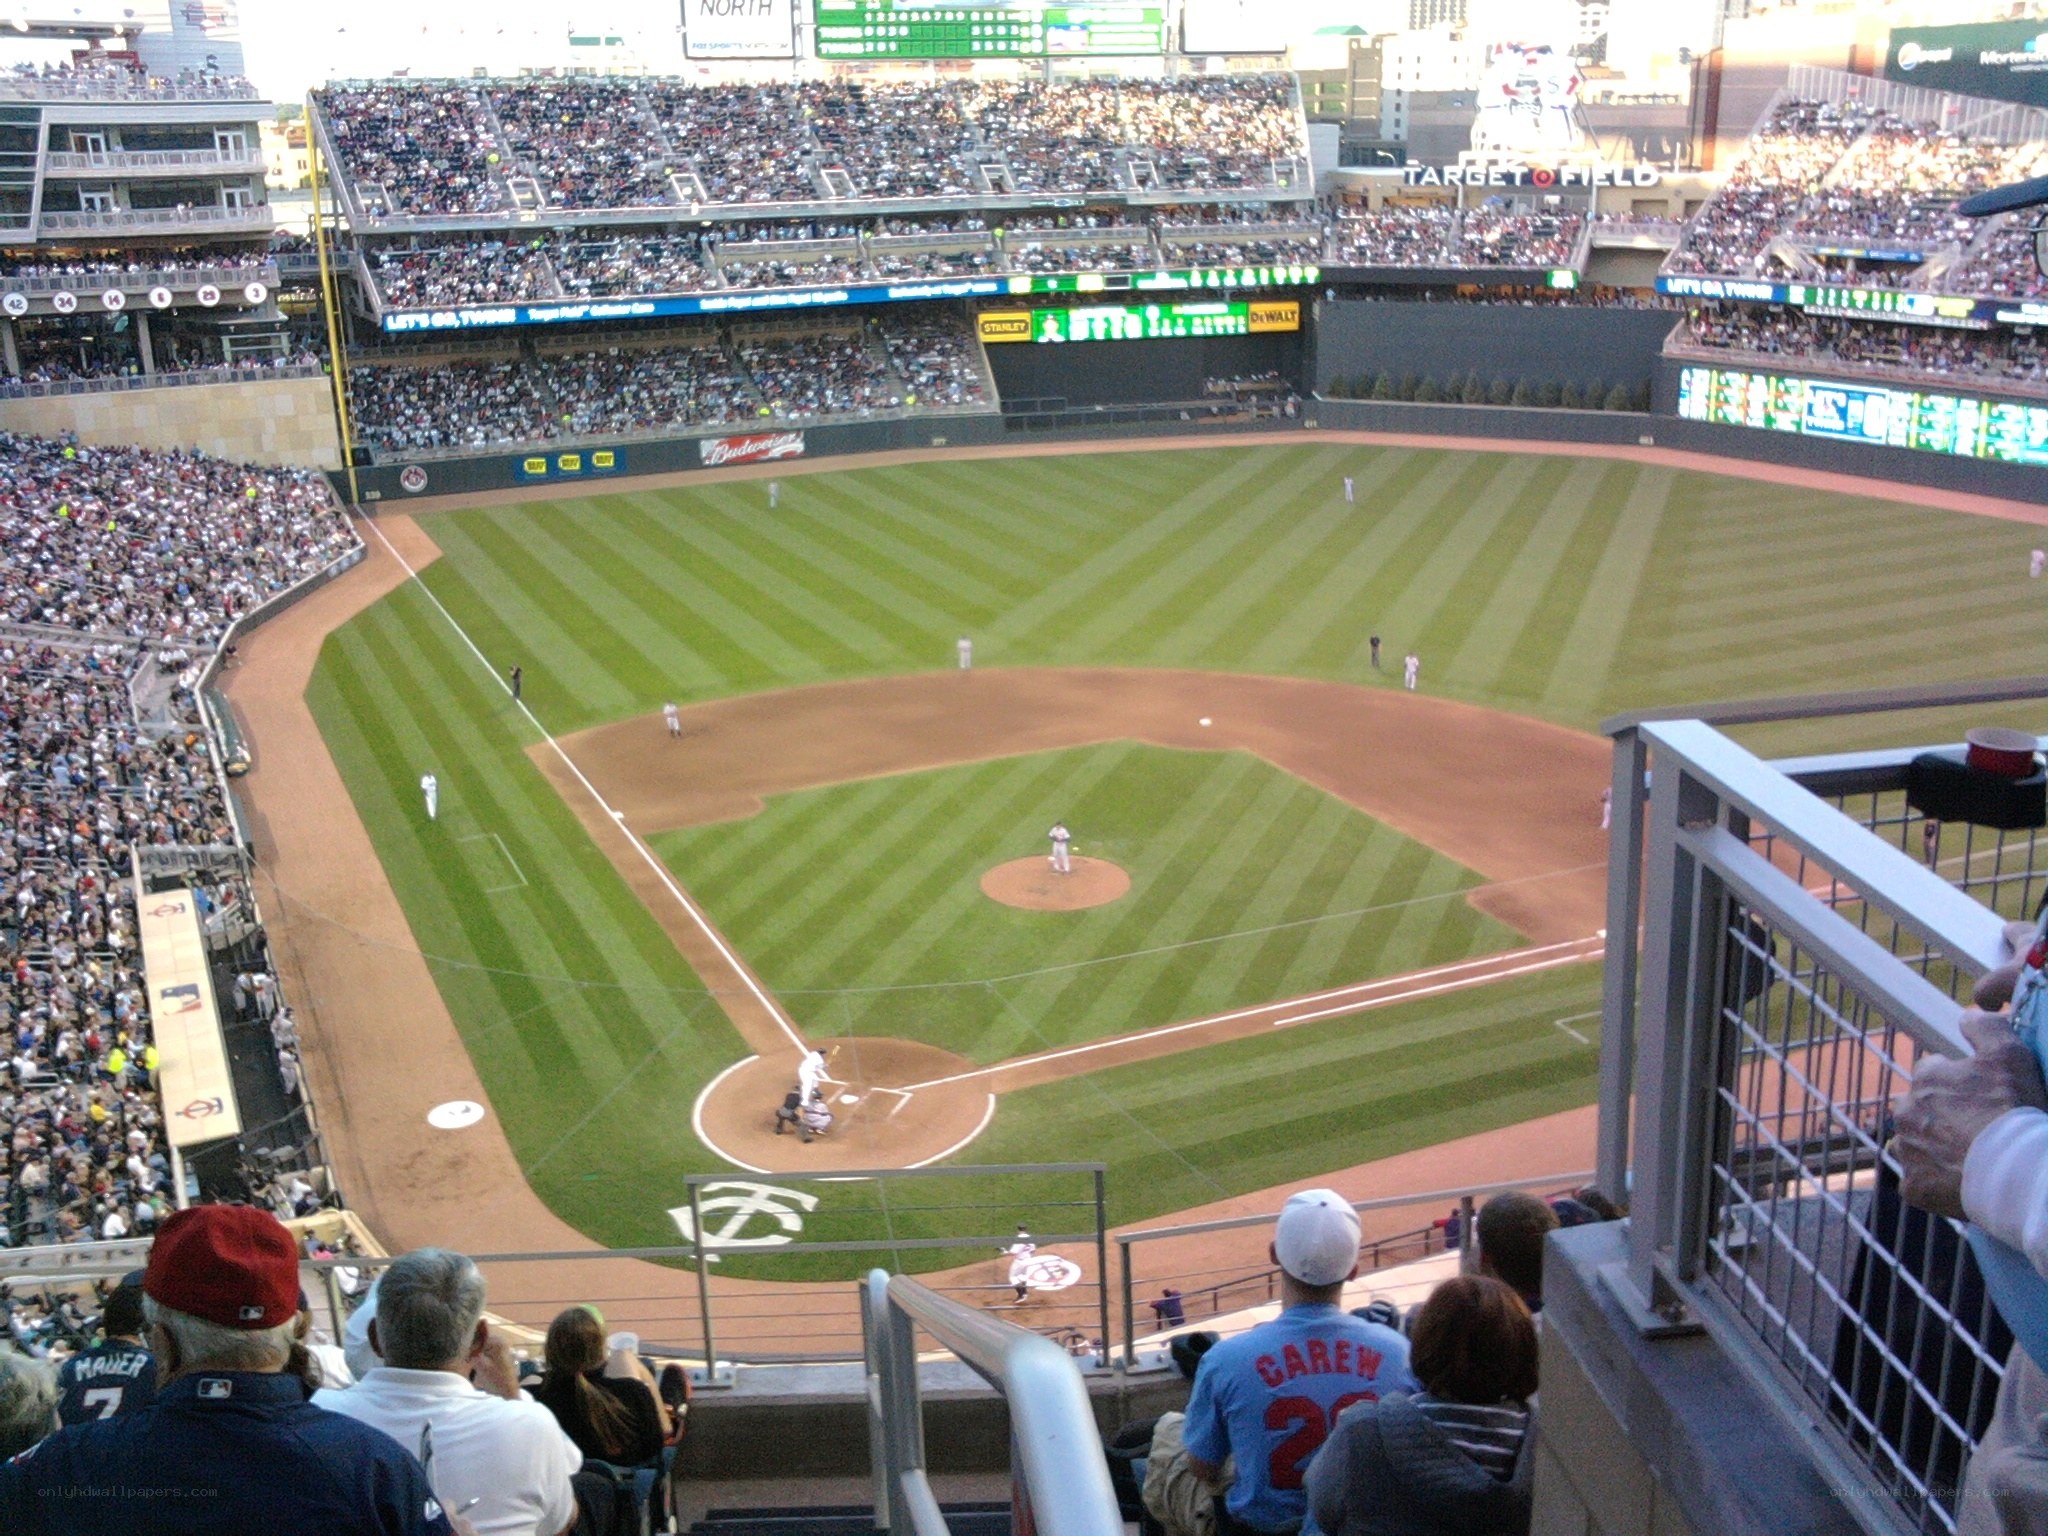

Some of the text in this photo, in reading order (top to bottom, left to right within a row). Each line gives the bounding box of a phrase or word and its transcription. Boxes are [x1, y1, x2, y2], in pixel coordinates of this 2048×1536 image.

[1403, 165, 1660, 188] TARGET FIELD
[9, 299, 23, 310] 42
[58, 297, 73, 308] 34
[108, 295, 120, 306] 14
[983, 321, 1027, 333] STANLEY
[705, 432, 803, 465] Budweiser
[75, 1353, 149, 1382] MAUER
[1256, 1339, 1383, 1387] CAREW
[83, 1387, 124, 1420] 7
[1264, 1391, 1379, 1491] 2
